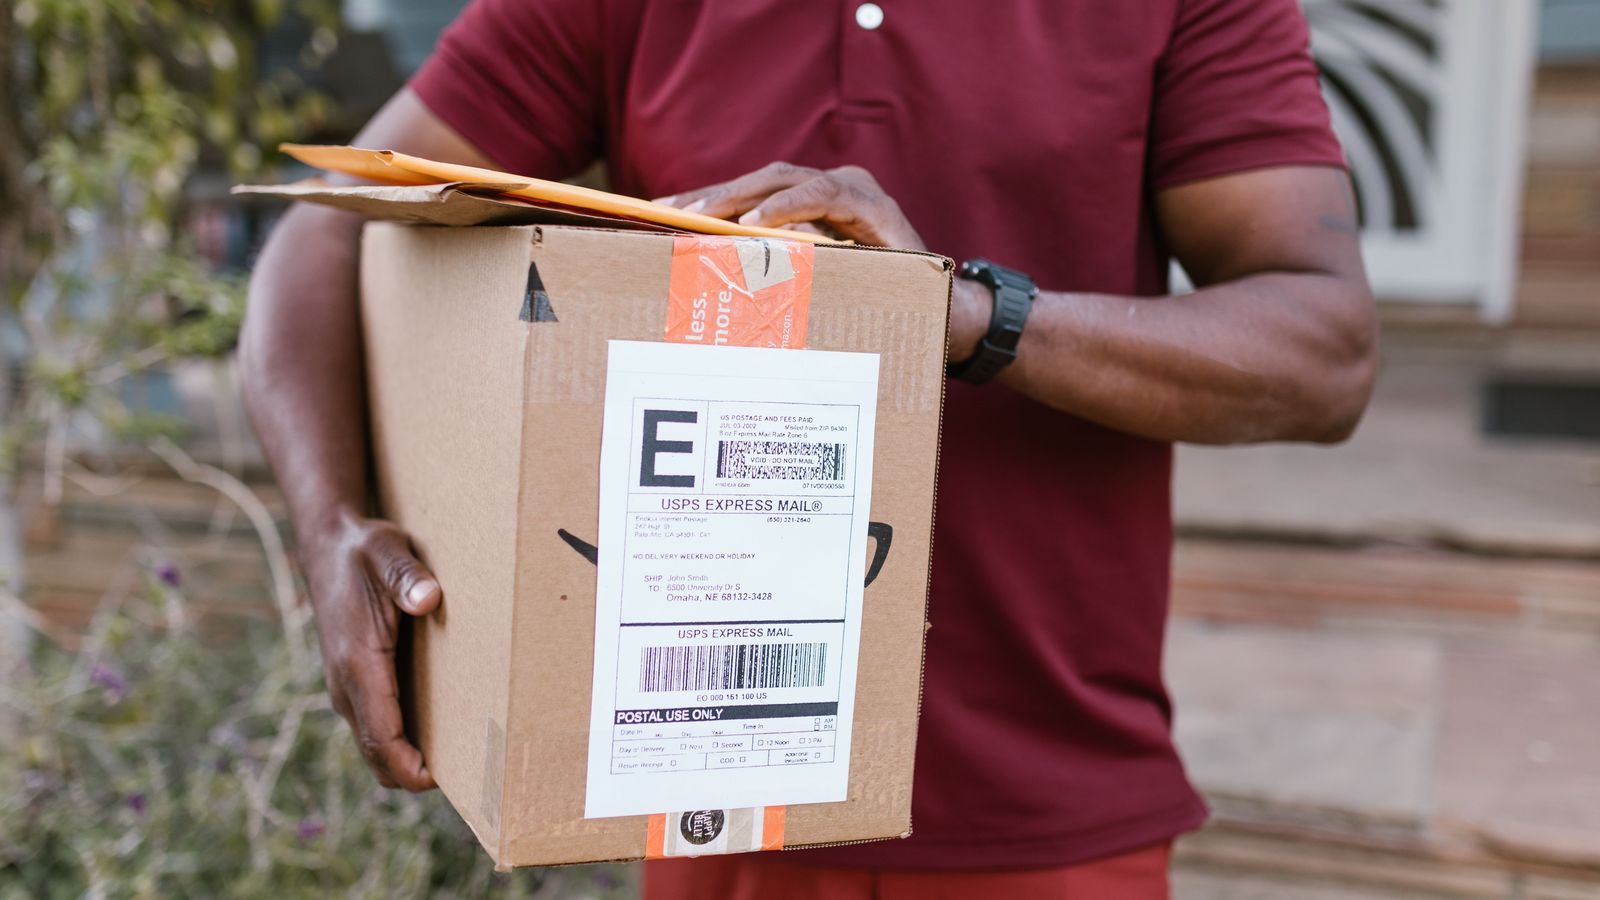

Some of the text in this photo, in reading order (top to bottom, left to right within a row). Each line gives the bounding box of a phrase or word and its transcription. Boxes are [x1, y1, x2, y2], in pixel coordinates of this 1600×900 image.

[685, 291, 708, 341] less.
[764, 415, 778, 423] AND
[798, 416, 813, 424] PAID
[640, 409, 697, 487] E
[661, 497, 700, 511] USPS
[705, 499, 773, 512] EXPRESS
[645, 552, 678, 560] DELVERY
[679, 552, 714, 560] WEEKEND
[715, 552, 726, 560] OR
[727, 552, 756, 560] HOLIDAY
[667, 574, 686, 582] John
[687, 574, 709, 582] Smith
[687, 584, 723, 593] University
[666, 592, 772, 603] Omaha, NE 68132-3428
[677, 627, 793, 640] USPS EXPRESS MAIL
[756, 692, 768, 700] US
[616, 708, 724, 724] POSTAL USE ONLY
[693, 814, 703, 838] BELLY
